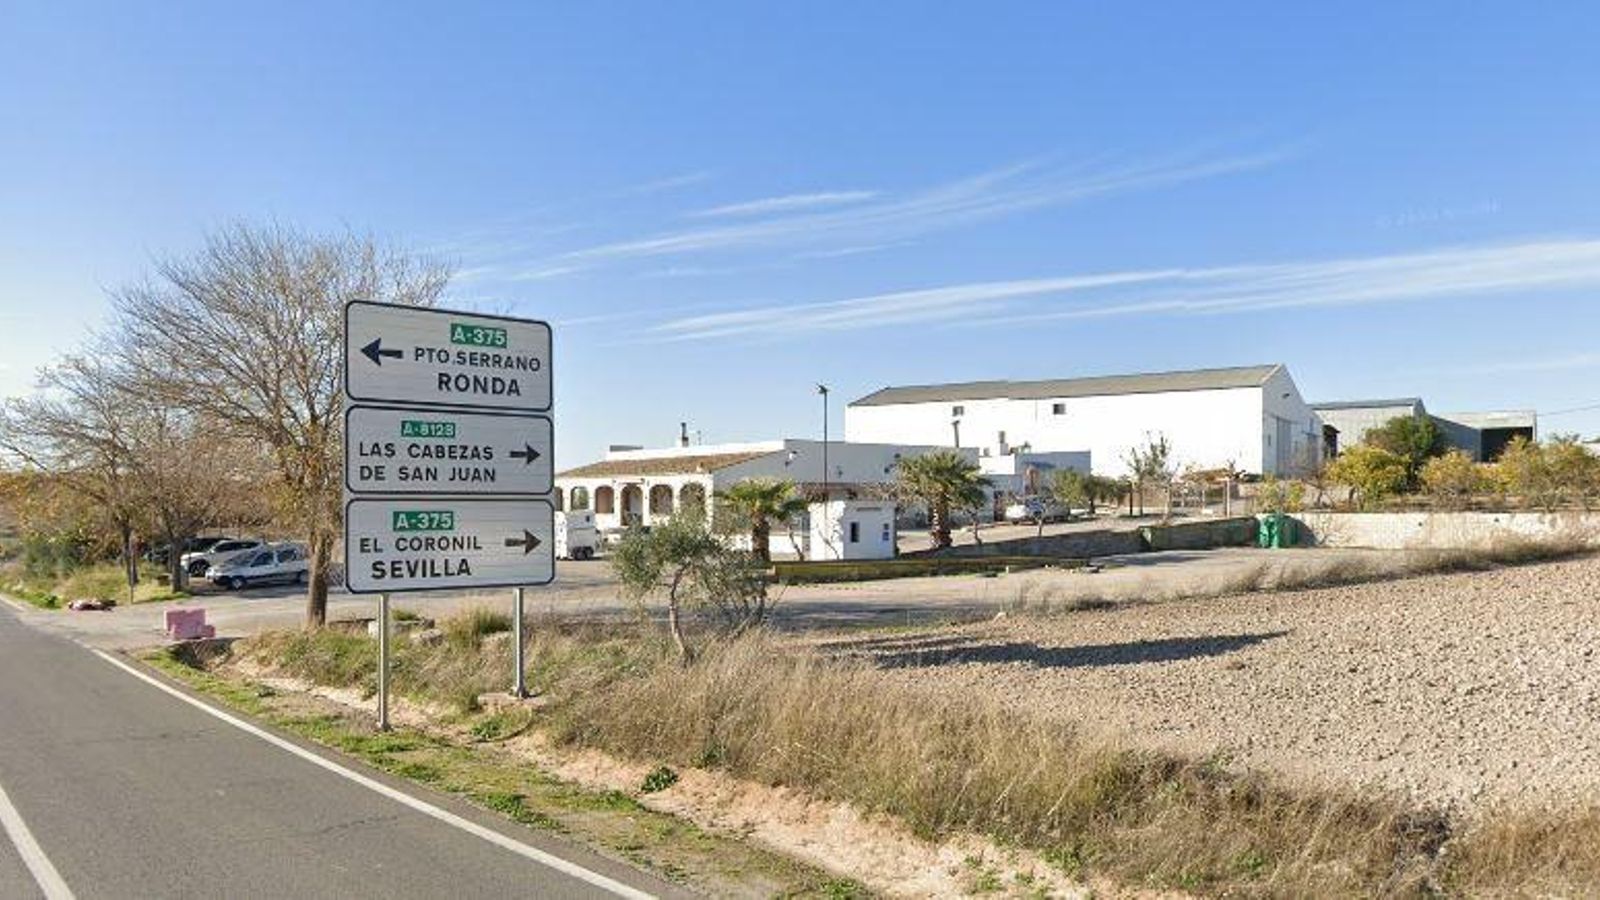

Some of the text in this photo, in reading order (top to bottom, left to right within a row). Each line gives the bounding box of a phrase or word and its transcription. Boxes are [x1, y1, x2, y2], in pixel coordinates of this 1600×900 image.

[451, 324, 507, 346] A-375
[437, 373, 522, 396] RONDA
[359, 442, 494, 461] LAS CABEZAS
[359, 465, 496, 482] DE SAN JUAN
[395, 512, 453, 530] A-375
[359, 535, 482, 553] EL CORONIL
[371, 558, 472, 579] SEVILLA
